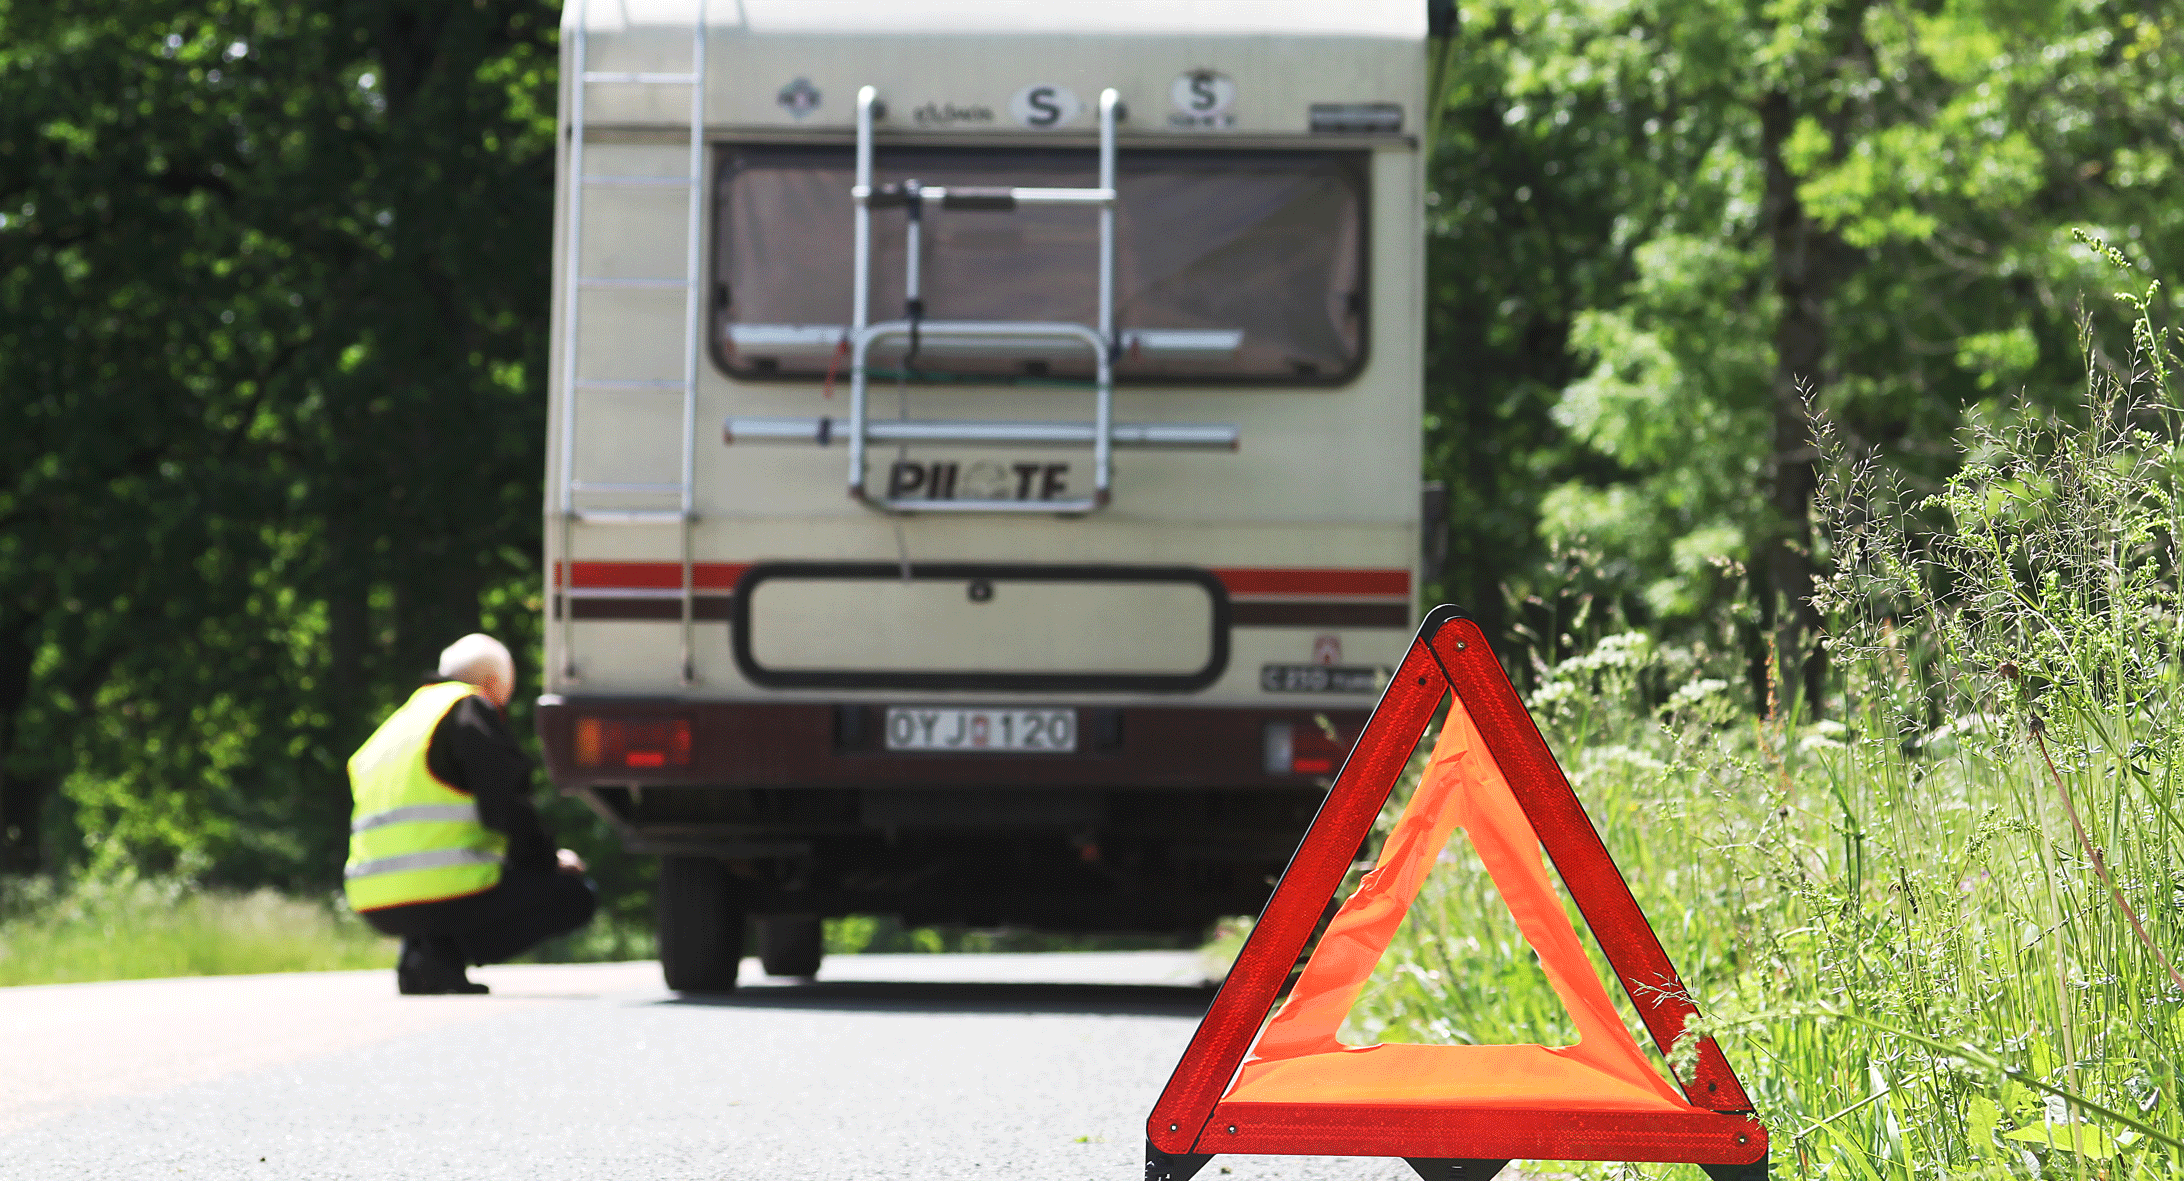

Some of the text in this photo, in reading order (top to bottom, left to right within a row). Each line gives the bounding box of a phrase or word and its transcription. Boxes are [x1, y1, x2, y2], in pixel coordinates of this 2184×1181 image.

[1026, 86, 1062, 128] S
[1189, 78, 1218, 111] S
[1002, 712, 1072, 747] 120
